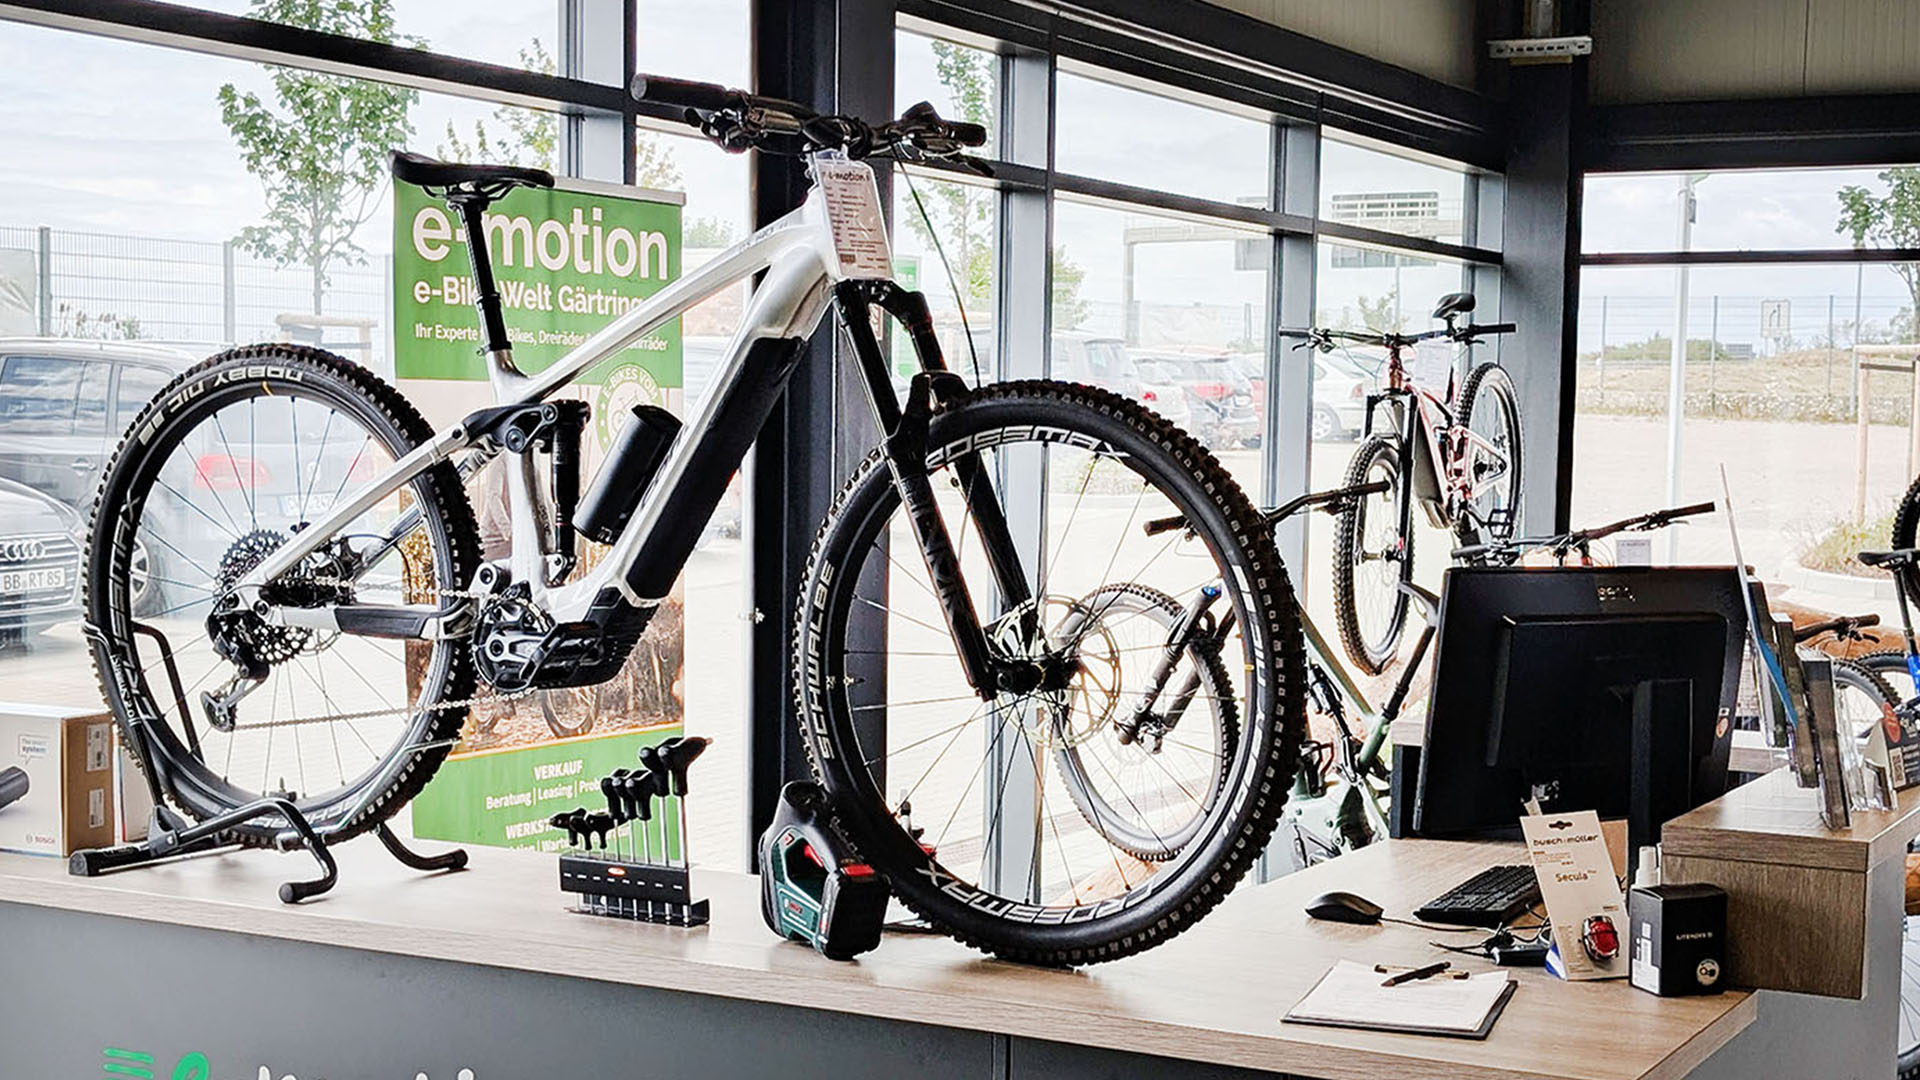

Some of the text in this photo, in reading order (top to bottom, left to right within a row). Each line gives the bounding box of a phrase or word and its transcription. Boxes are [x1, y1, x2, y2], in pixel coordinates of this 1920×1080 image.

[414, 276, 476, 305] e-Bik
[558, 284, 643, 315] Gärtring
[415, 323, 433, 338] Ihr
[168, 366, 304, 411] NOBBY NIC
[925, 425, 1130, 470] ROSSMAX
[4, 574, 21, 590] BB
[29, 571, 43, 588] RT
[1597, 586, 1636, 602] Be
[804, 559, 835, 760] SCHWALBE
[534, 760, 583, 780] VERKAUF
[486, 791, 531, 810] Beratung
[538, 783, 573, 800] Leasing
[505, 818, 552, 840] WERKST
[916, 866, 1151, 924] CROSSMAX
